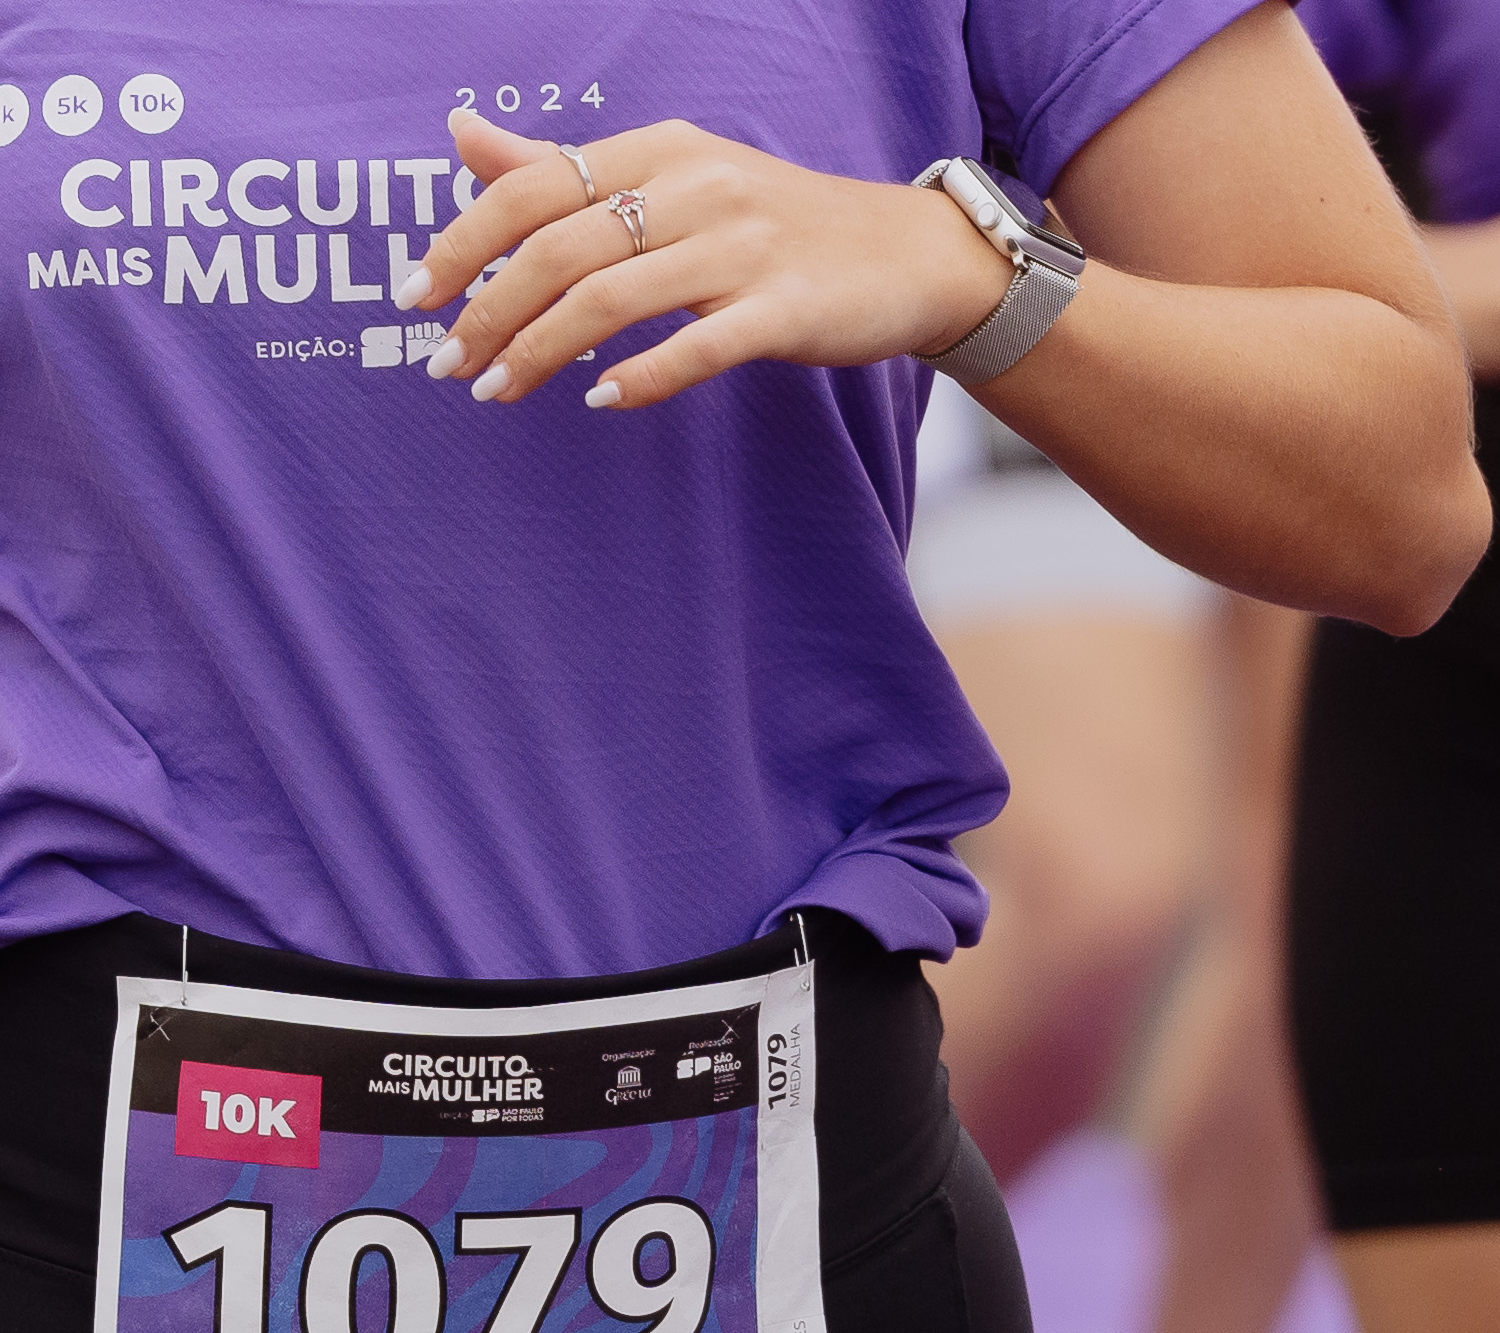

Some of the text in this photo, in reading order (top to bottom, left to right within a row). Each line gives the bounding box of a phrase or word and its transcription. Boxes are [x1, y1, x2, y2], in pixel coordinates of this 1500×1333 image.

[56, 95, 89, 115] 5k
[129, 93, 177, 113] 10k
[455, 81, 606, 115] 2024
[27, 247, 154, 290] MAIS
[255, 337, 356, 361] EDIÇÃO:
[382, 1052, 529, 1078] CIRCUITO
[713, 1051, 733, 1064] SÃO
[713, 1060, 742, 1074] PAULO
[766, 1033, 788, 1111] 1079
[789, 1022, 801, 1108] MEDALHA
[368, 1077, 544, 1102] MAIS MULHER
[200, 1089, 298, 1140] 10K
[163, 1194, 716, 1333] 1079
